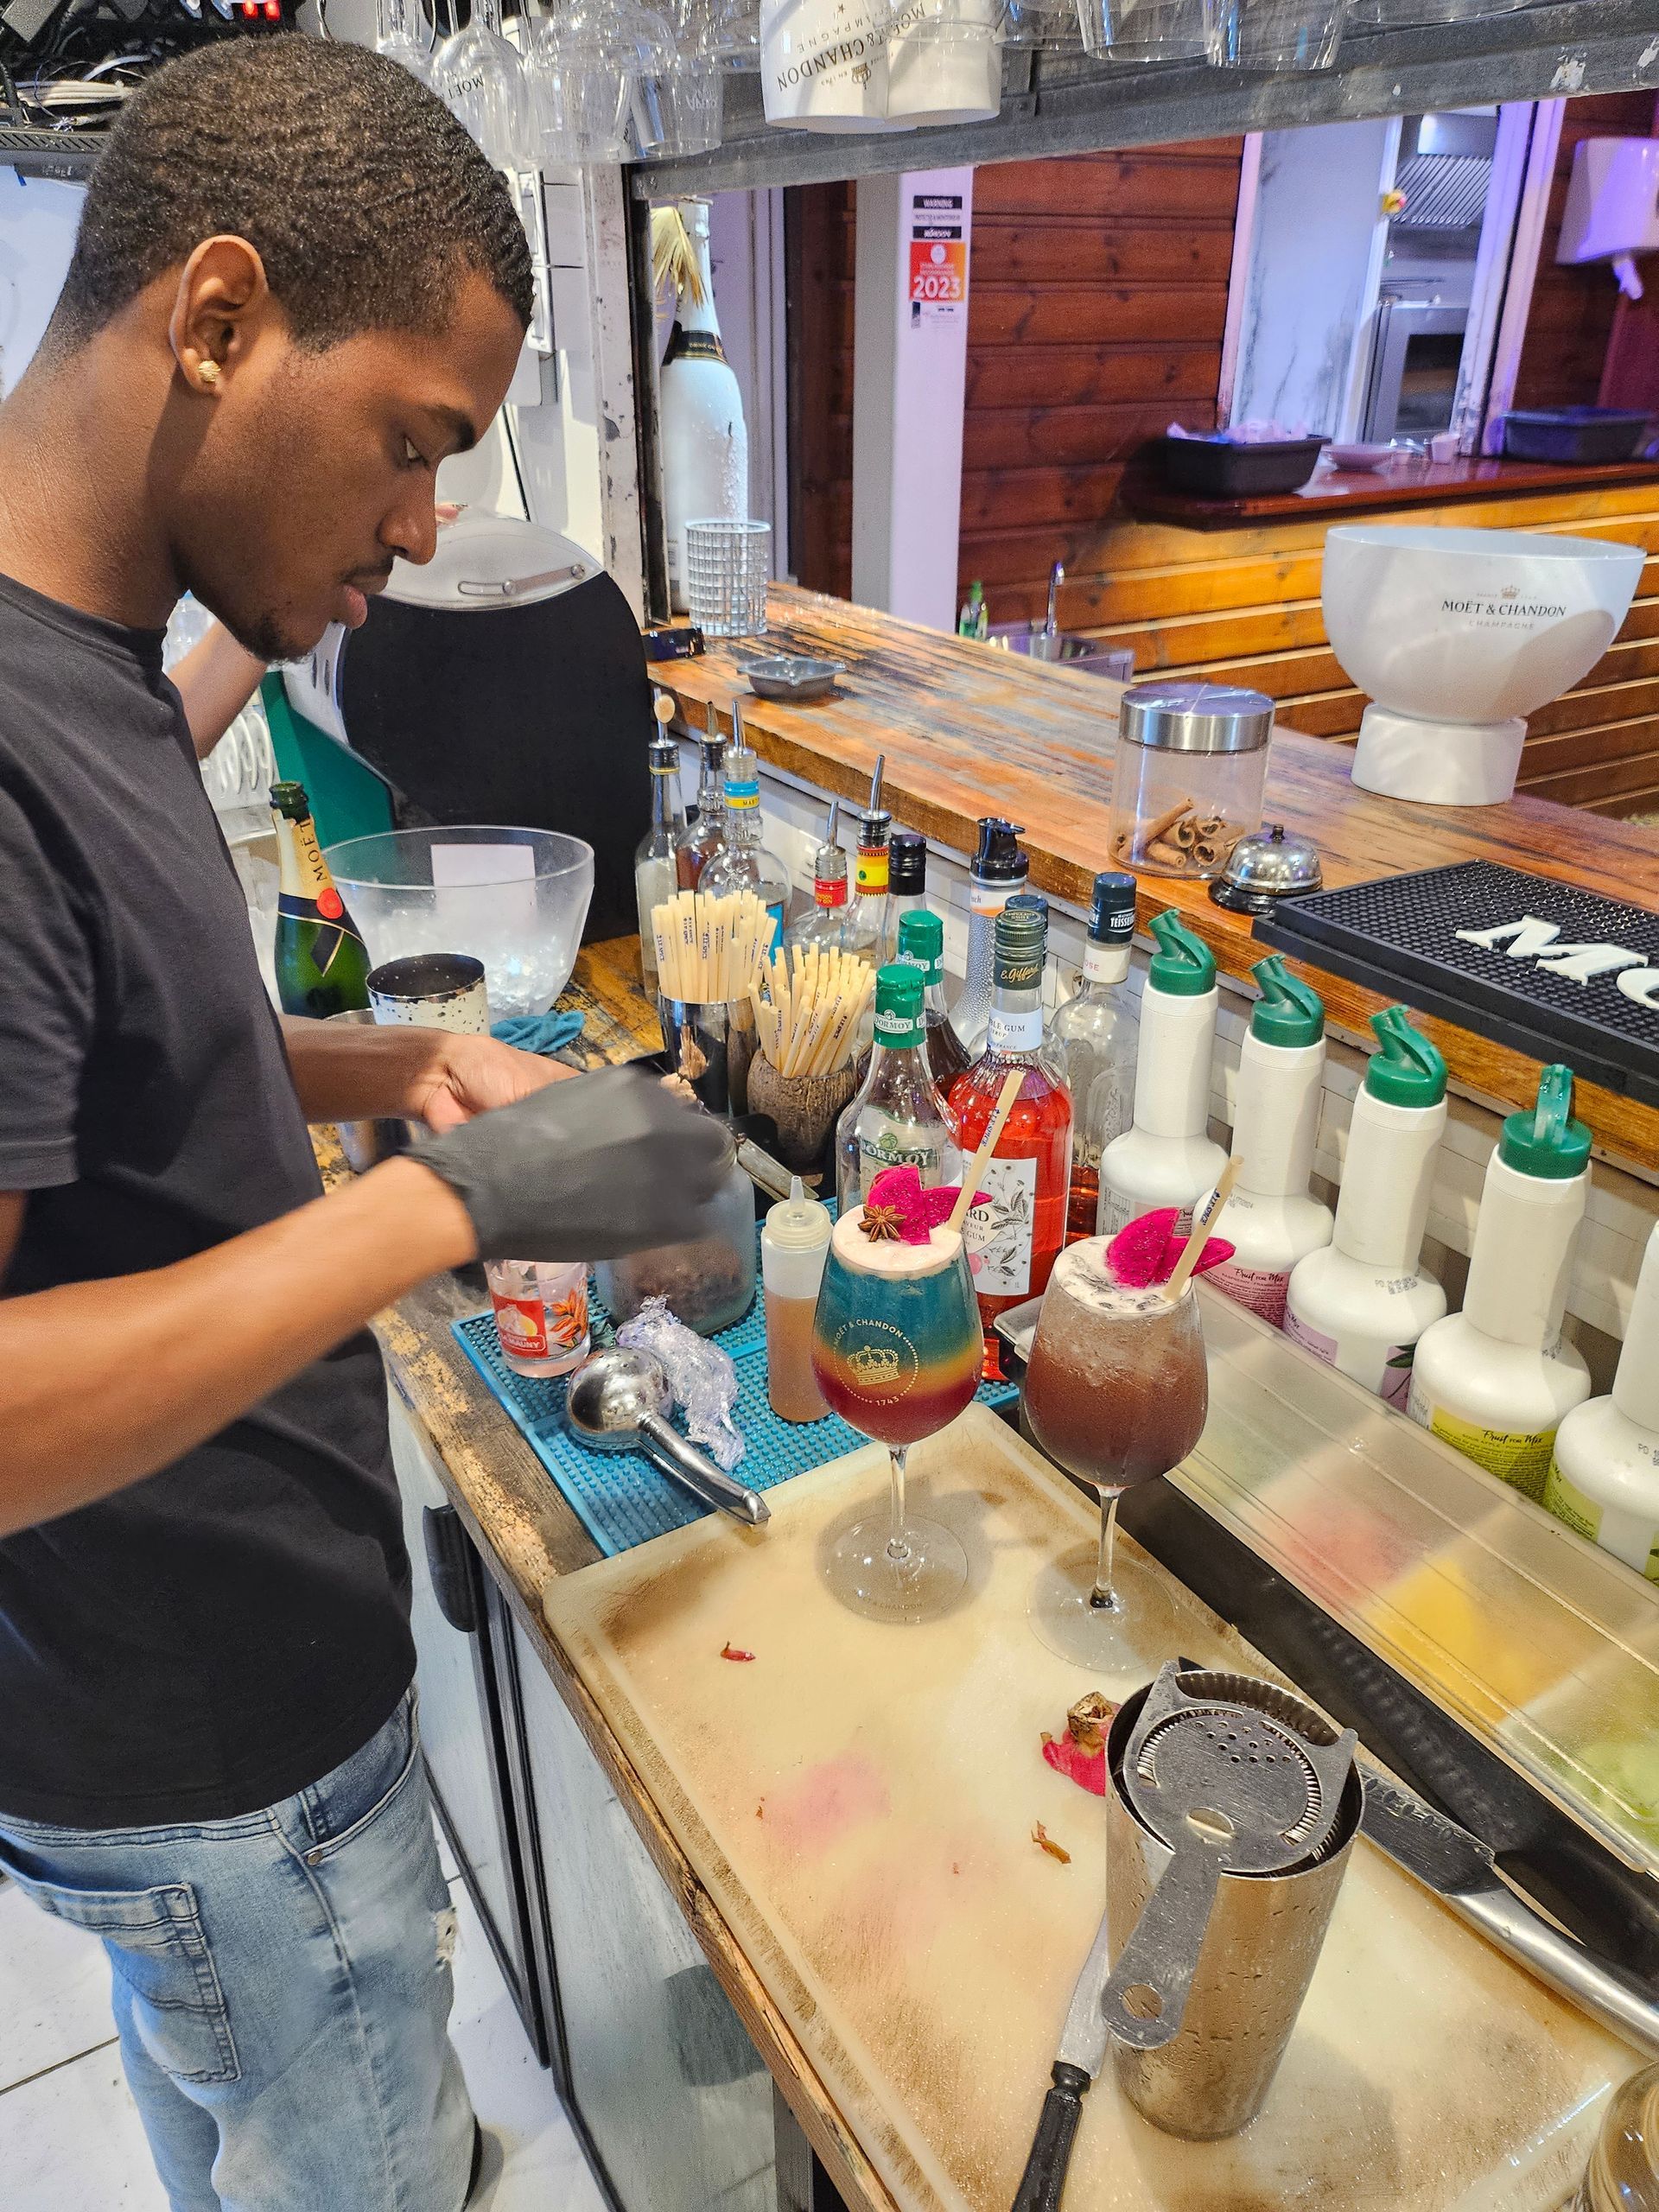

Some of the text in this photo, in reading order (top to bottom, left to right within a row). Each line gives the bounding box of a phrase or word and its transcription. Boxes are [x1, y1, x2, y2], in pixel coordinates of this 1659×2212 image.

[866, 34, 876, 48] &
[778, 38, 865, 92] CHANDON
[913, 276, 960, 298] 2023
[1441, 599, 1567, 618] MOËT & CHANDON
[1469, 620, 1535, 631] CHAMPAGNE
[300, 821, 327, 881] MOËT
[1004, 1024, 1026, 1033] GUM
[966, 1230, 986, 1242] GUM
[1234, 1268, 1255, 1281] Fruit
[1268, 1273, 1285, 1284] Mix
[856, 1319, 904, 1338] CHANDON
[875, 1395, 899, 1407] 1743
[1482, 1429, 1509, 1444] Fruit
[1523, 1434, 1543, 1446] Mix
